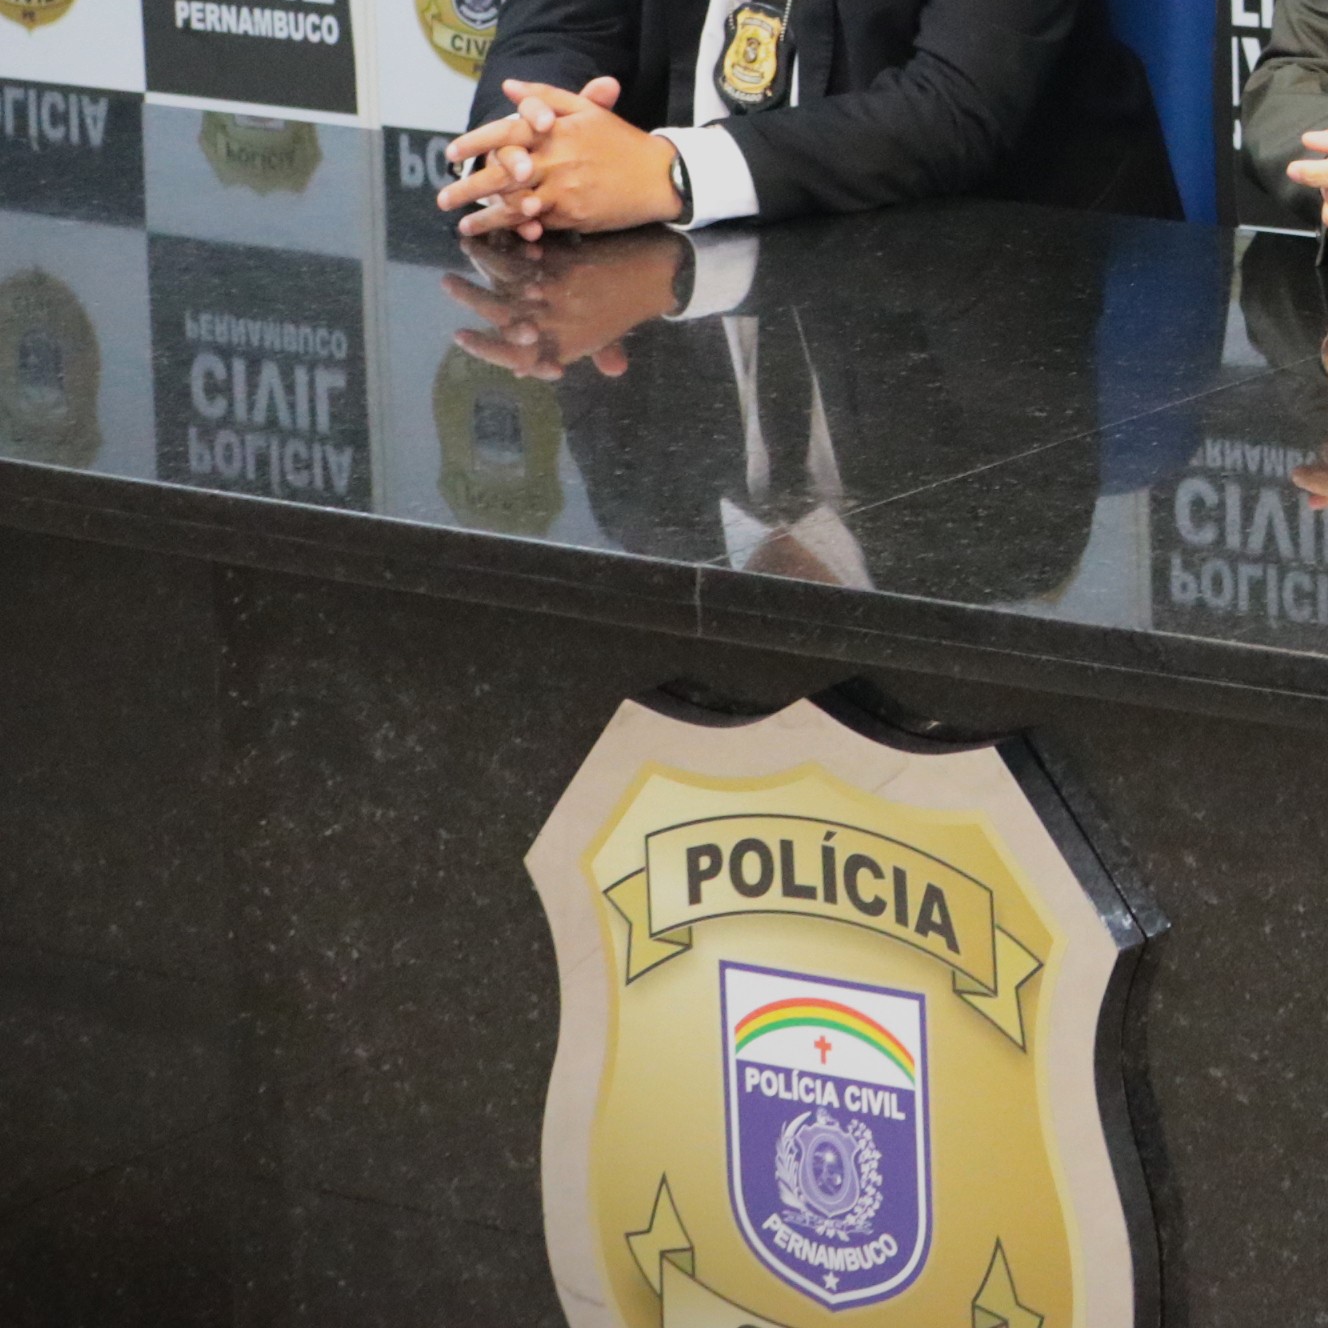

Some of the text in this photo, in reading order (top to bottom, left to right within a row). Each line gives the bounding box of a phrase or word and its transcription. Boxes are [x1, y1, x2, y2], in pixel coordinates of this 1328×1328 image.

[175, 0, 339, 44] PERNAMBUCO
[450, 32, 492, 57] CIV
[686, 830, 960, 955] POLÍCIA
[745, 1067, 905, 1121] POLÍCIA CIVIL
[762, 1213, 898, 1272] PERNAMBUCO
